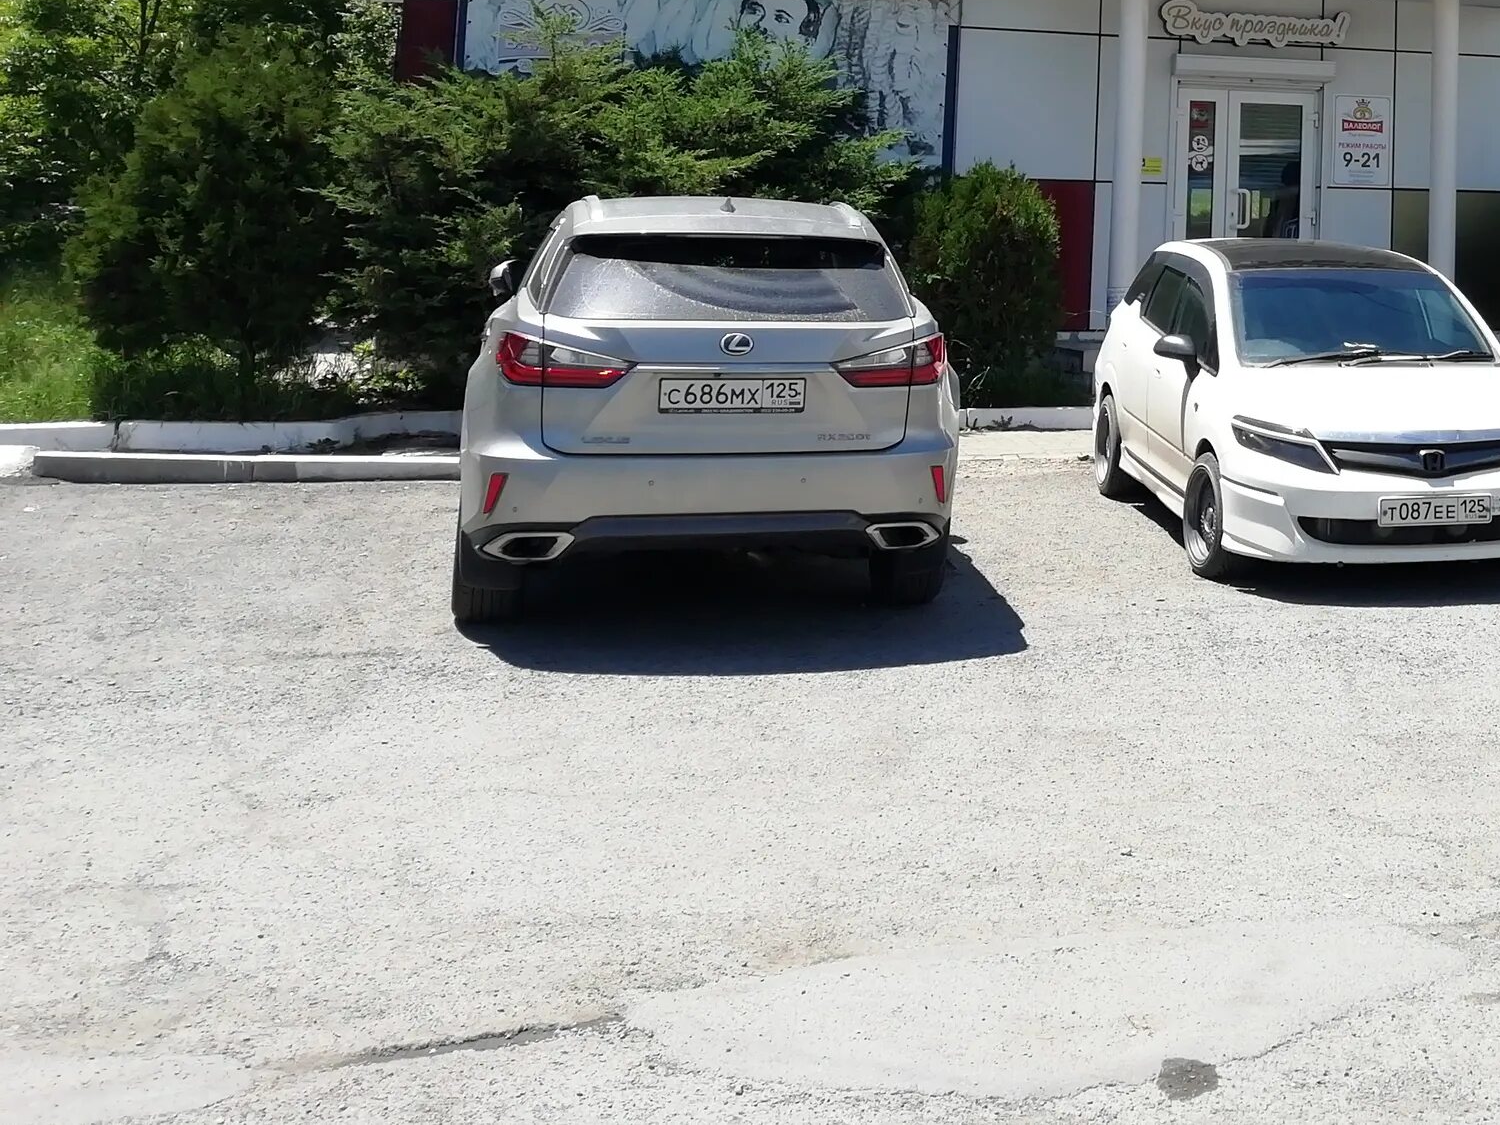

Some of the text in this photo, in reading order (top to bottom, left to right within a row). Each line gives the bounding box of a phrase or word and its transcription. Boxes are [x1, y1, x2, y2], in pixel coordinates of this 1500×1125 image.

[1167, 5, 1223, 38] Вкус
[1343, 151, 1380, 168] 9-21
[765, 382, 800, 399] 125
[1460, 499, 1486, 513] 125
